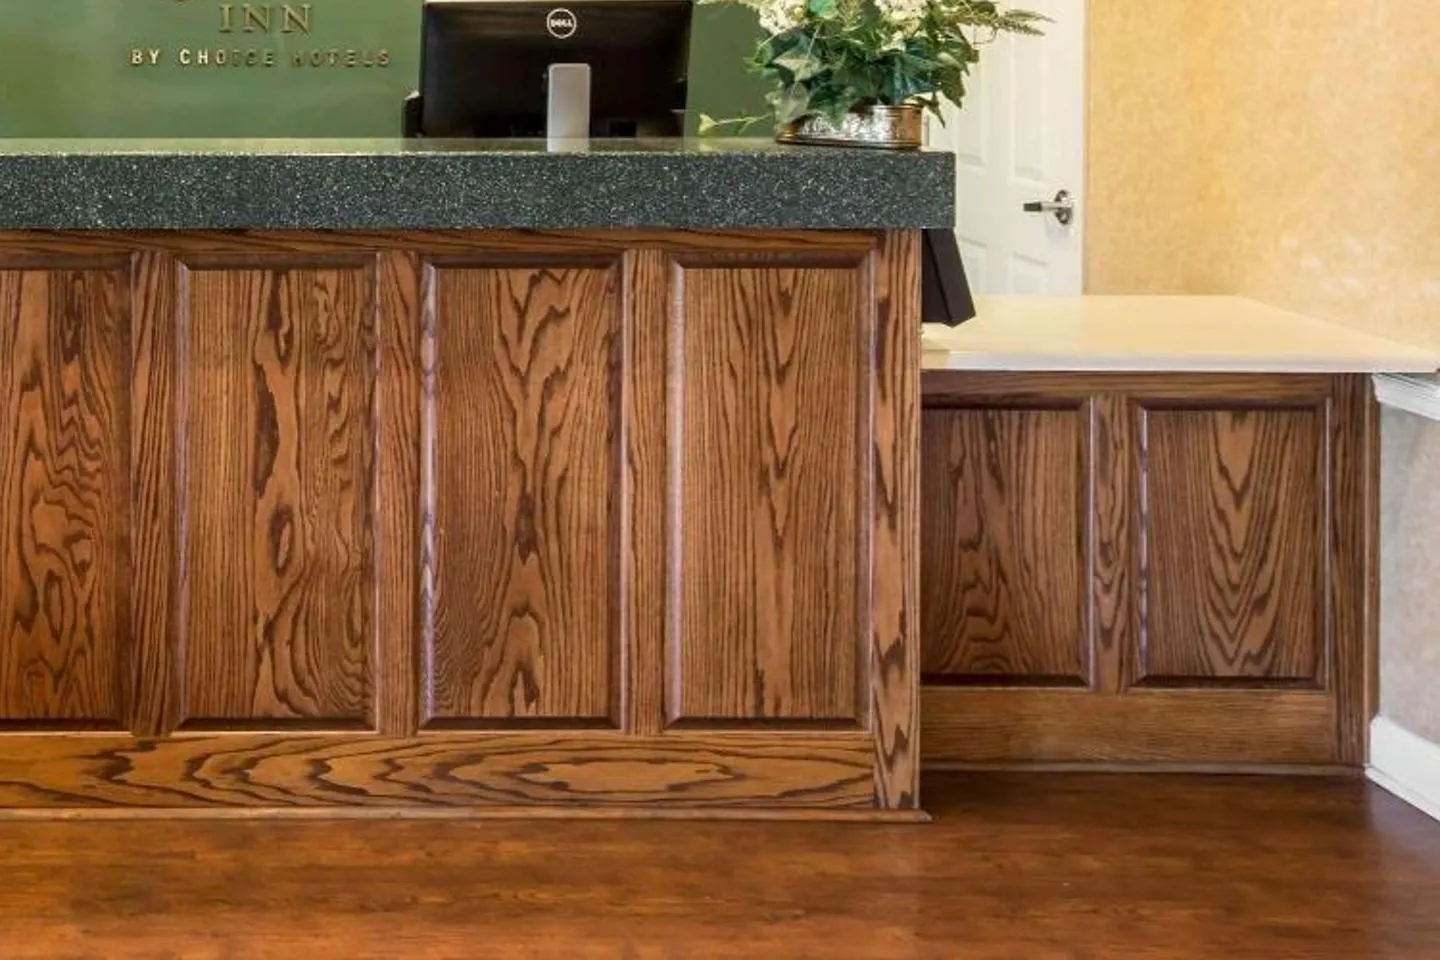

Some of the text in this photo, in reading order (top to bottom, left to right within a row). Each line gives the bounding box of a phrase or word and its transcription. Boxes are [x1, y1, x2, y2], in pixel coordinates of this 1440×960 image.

[218, 3, 312, 35] INN
[129, 49, 390, 68] BY CHOICE HOTELS
